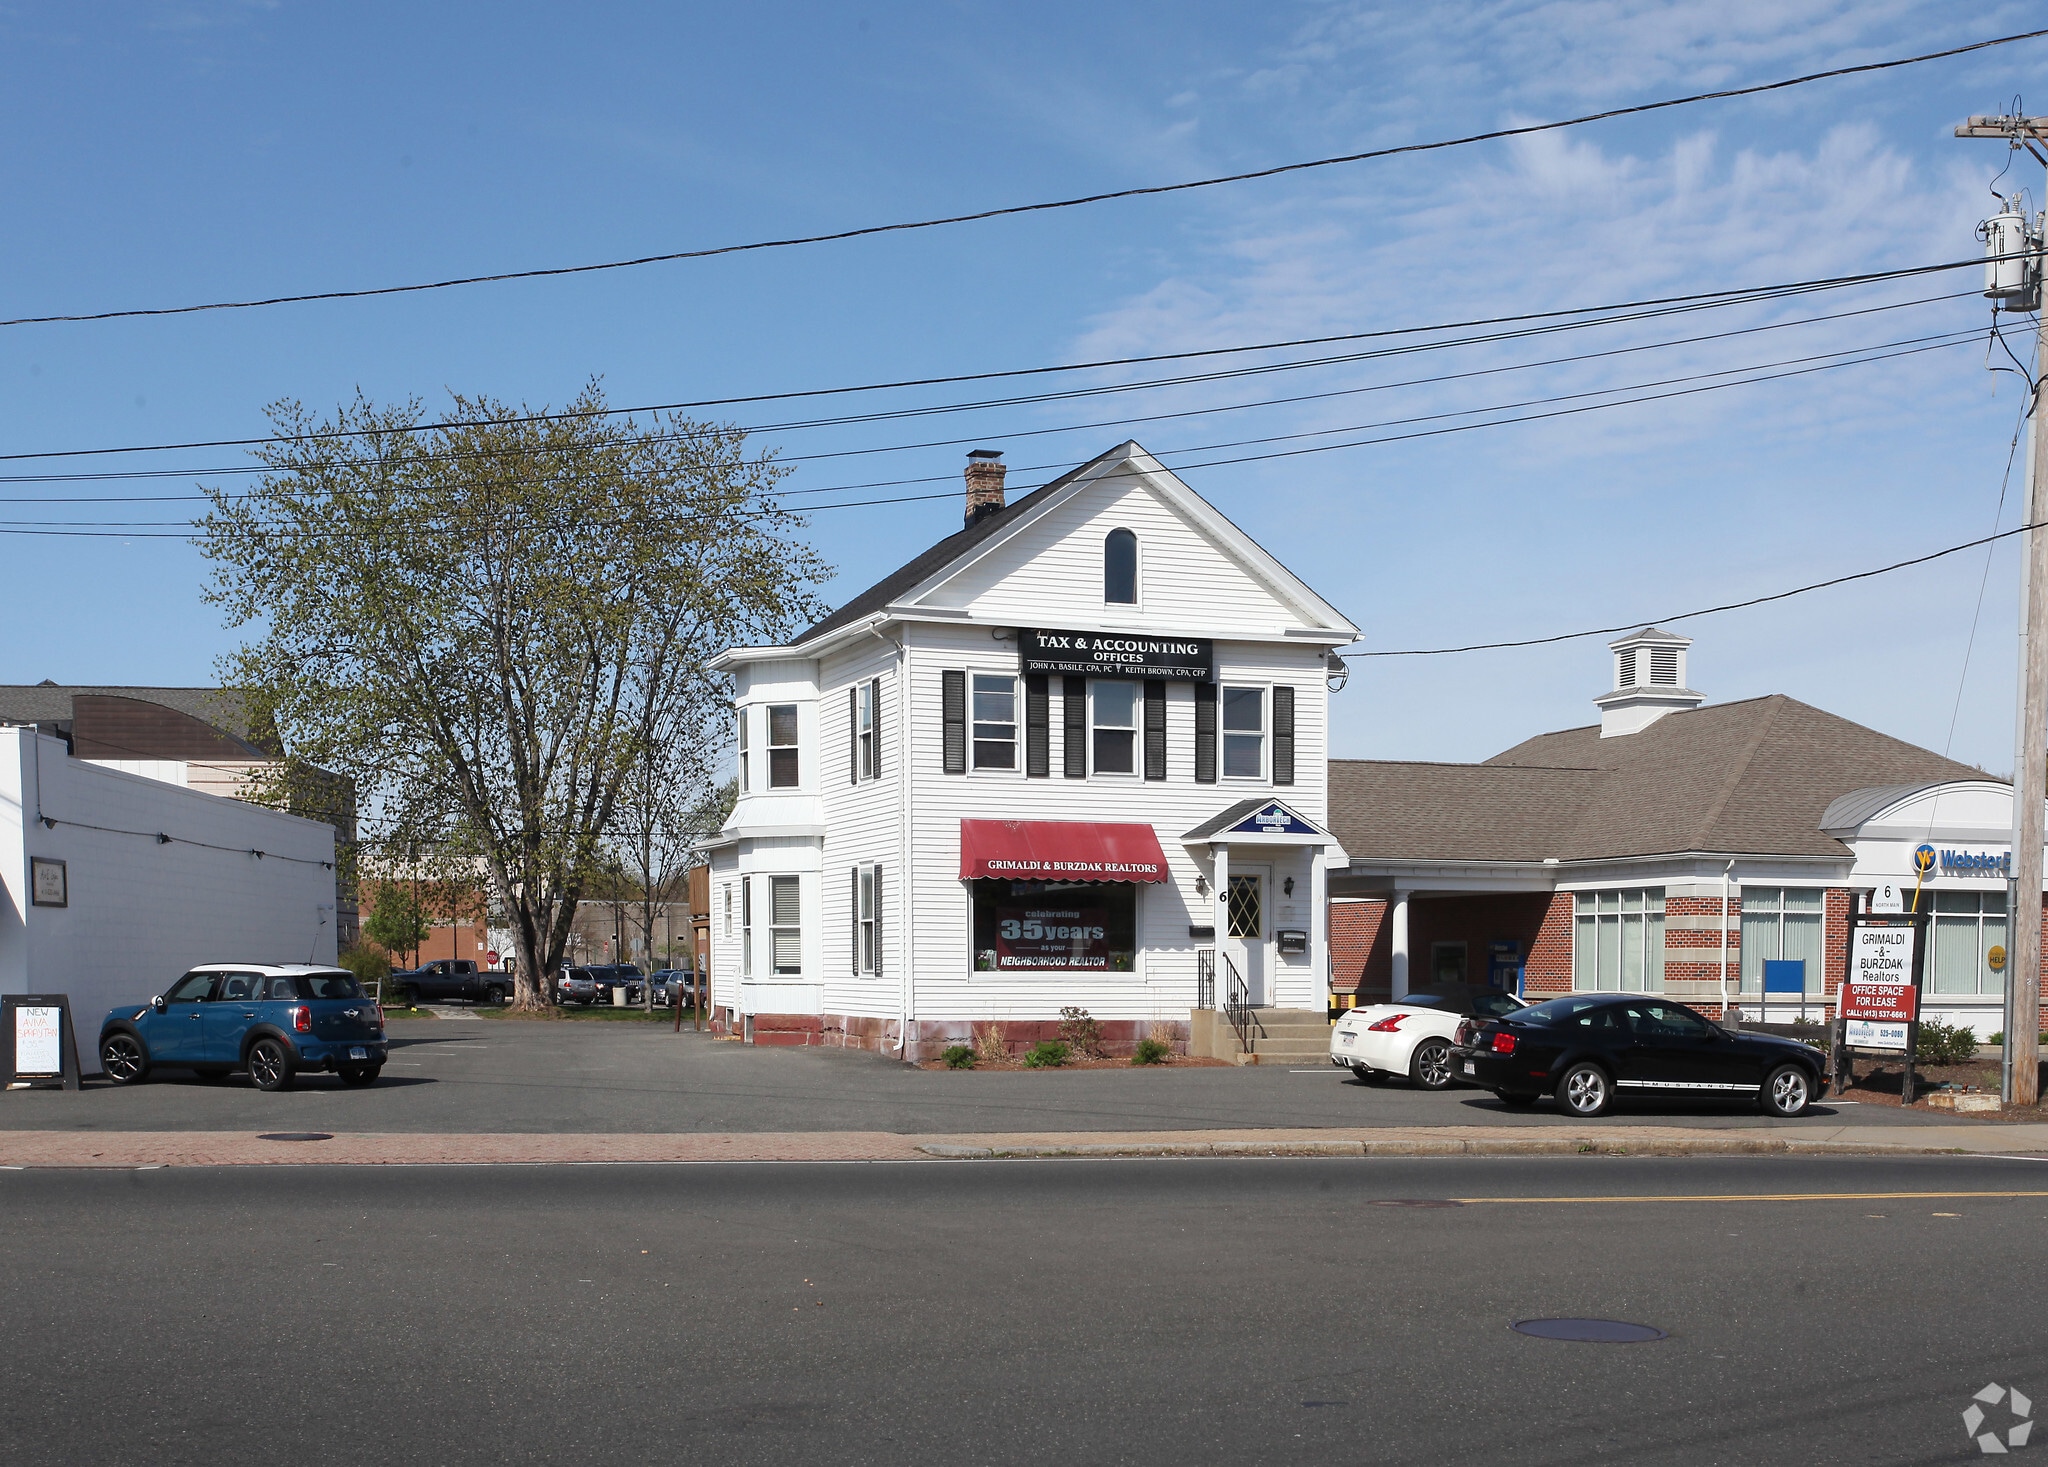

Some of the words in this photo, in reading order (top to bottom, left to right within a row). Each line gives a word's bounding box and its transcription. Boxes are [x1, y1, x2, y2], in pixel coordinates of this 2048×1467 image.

[1036, 635, 1070, 648] TAX
[1074, 638, 1088, 649] &
[1092, 638, 1198, 655] ACCOUNTING
[1094, 652, 1144, 662] OFFICES
[1030, 662, 1048, 670] JOHN
[1058, 663, 1084, 672] BASILE,
[1086, 665, 1101, 673] CPA,
[1148, 667, 1174, 676] BROWN,
[1176, 669, 1191, 677] CPA,
[1940, 850, 2011, 870] WebsterB
[988, 860, 1041, 870] GRIMALDI
[1043, 862, 1051, 870] &
[1054, 862, 1102, 872] BURZDAK
[1105, 863, 1157, 873] REALTORS
[1220, 891, 1227, 903] 6
[1884, 886, 1891, 898] 6
[1025, 910, 1080, 918] celebrating
[1862, 934, 1905, 944] GRIMALDI
[1000, 956, 1067, 966] NEIGHBORHOOD
[1069, 956, 1105, 967] REALTOR
[1860, 958, 1903, 969] BURZDAK
[1862, 970, 1900, 982] Realtors
[1852, 986, 1876, 995] OFFICE
[1878, 986, 1904, 996] SPACE
[1856, 997, 1870, 1006] FOR
[1872, 997, 1897, 1007] LEASE
[27, 1008, 48, 1016] NEW
[1863, 1010, 1877, 1018] (413)
[23, 1018, 48, 1027] AVIVA
